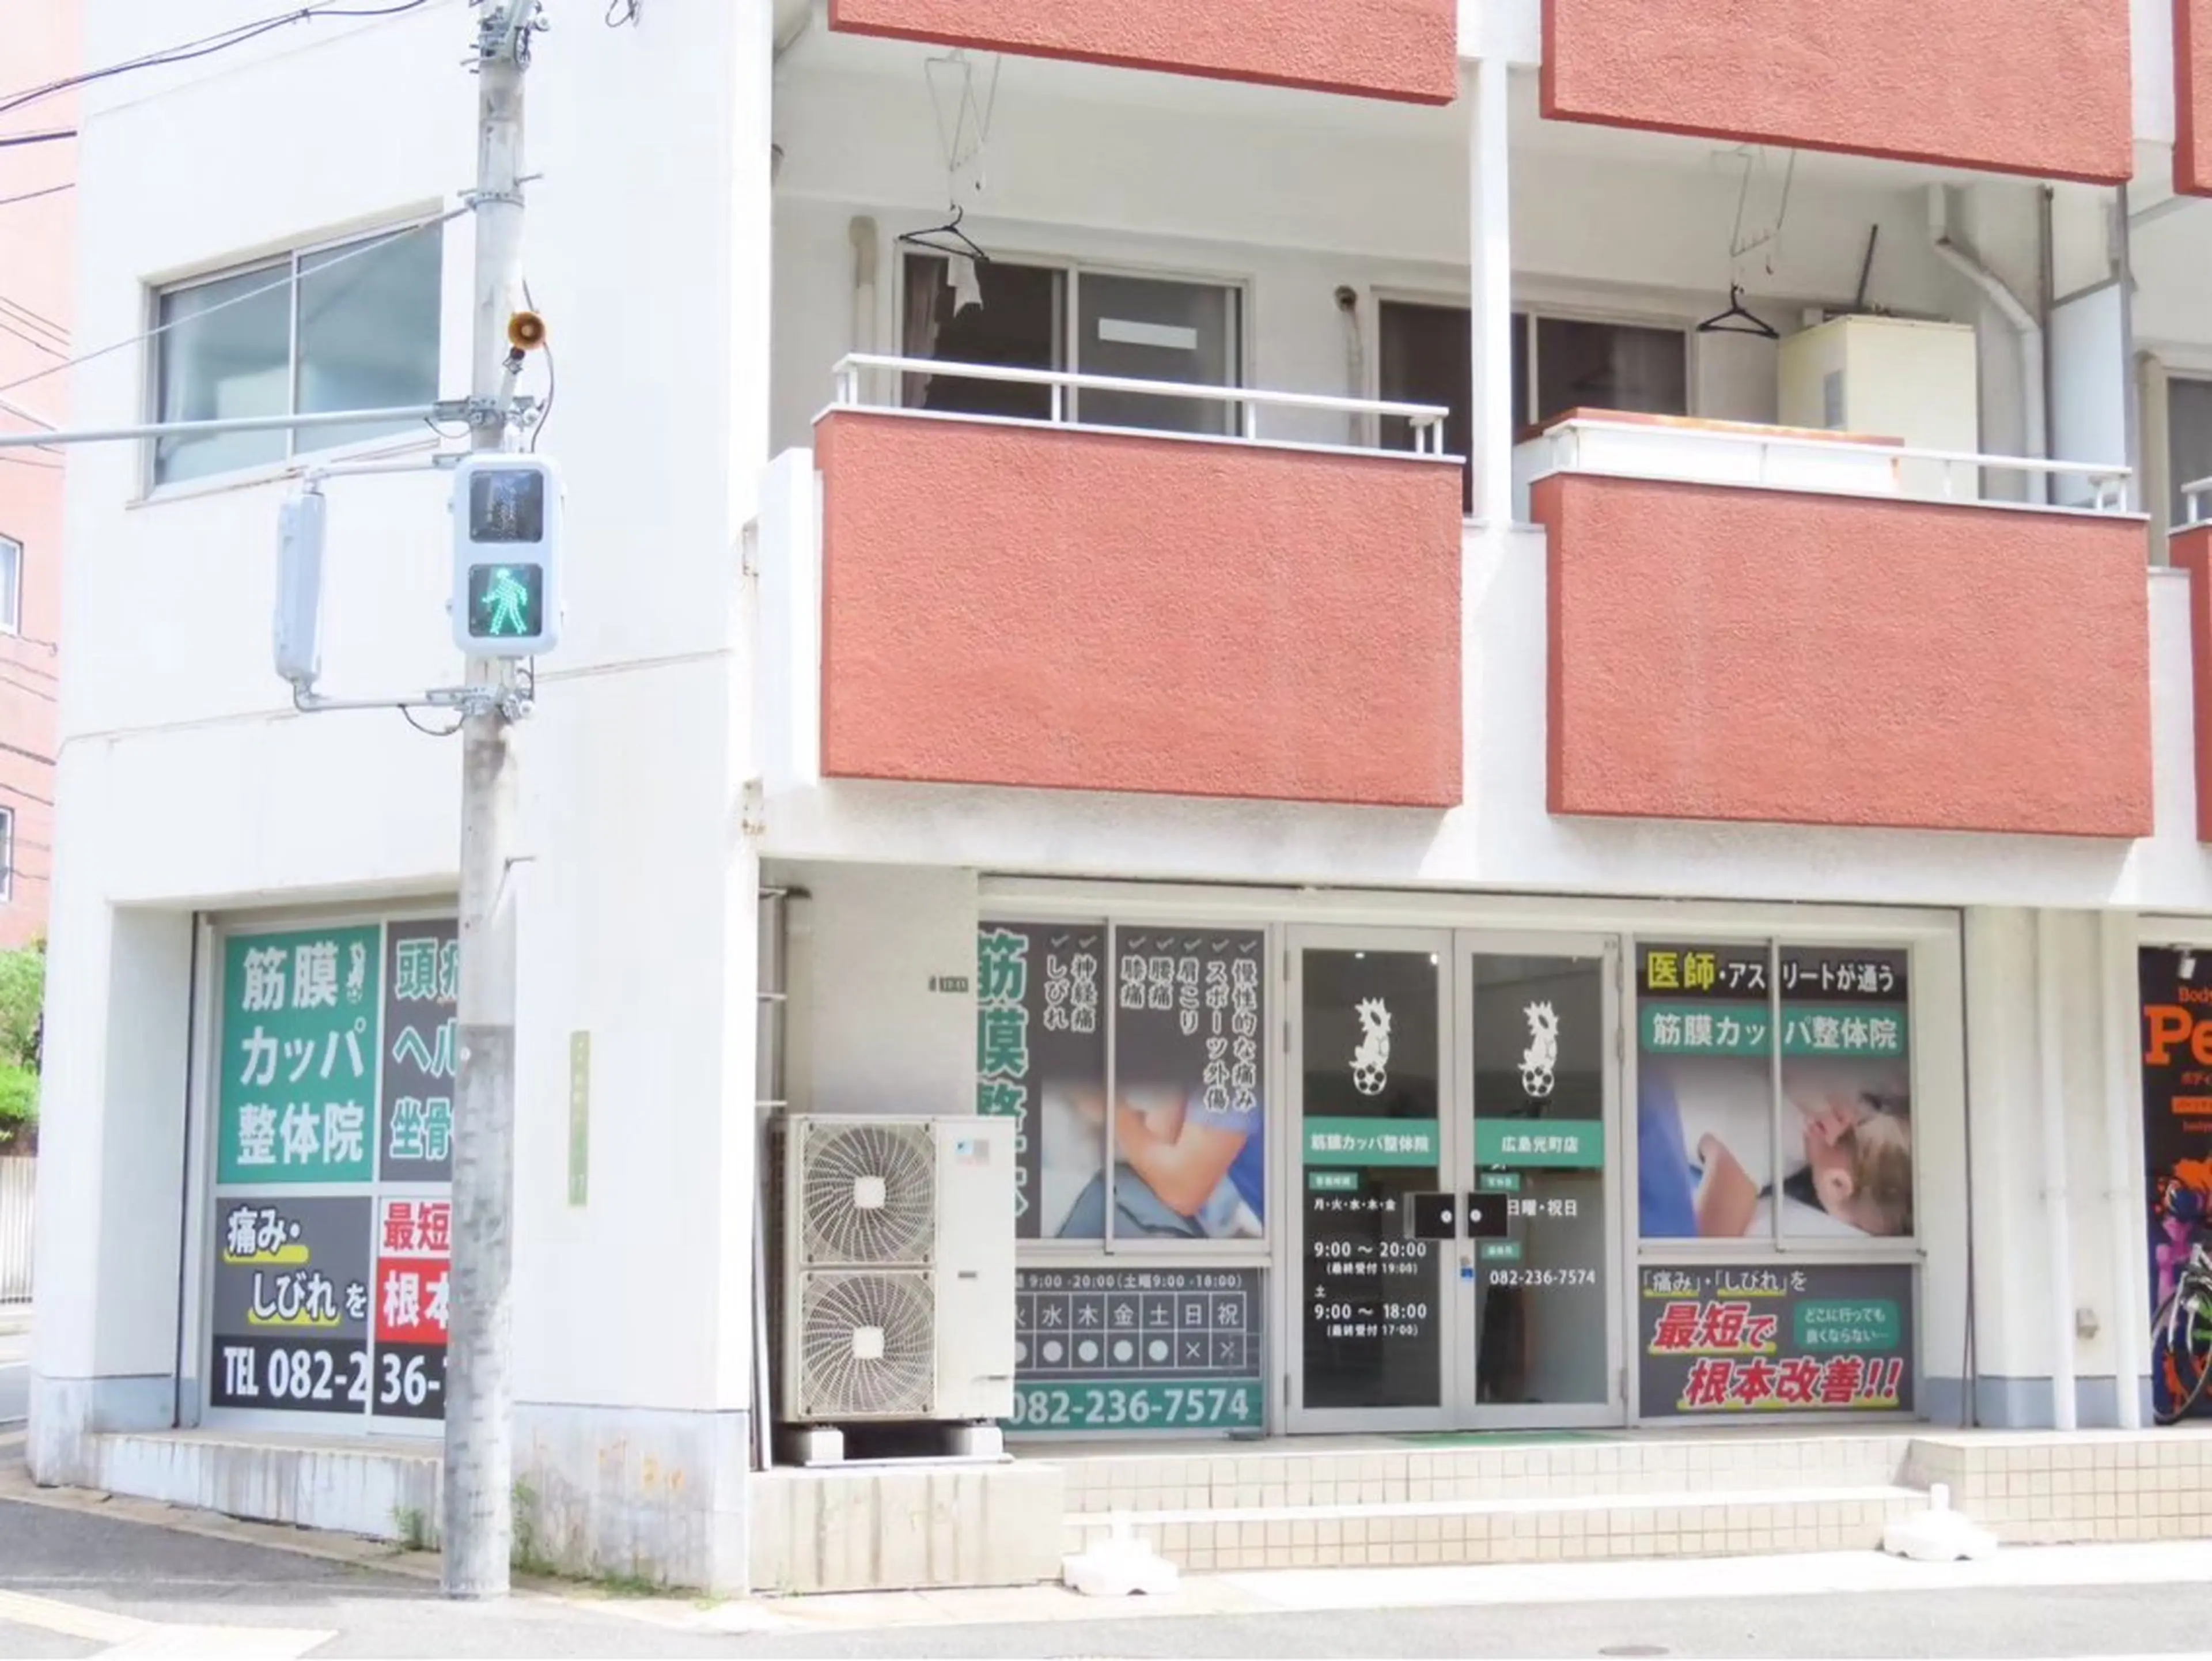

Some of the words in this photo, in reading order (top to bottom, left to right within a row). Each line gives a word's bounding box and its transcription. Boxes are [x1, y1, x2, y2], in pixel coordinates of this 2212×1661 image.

[242, 941, 340, 1012] 筋膜
[1043, 954, 1070, 1031] しびれ
[240, 1016, 367, 1086] カッパ
[1653, 1012, 1897, 1049] 筋膜カッパ整体院
[237, 1099, 364, 1165] 整体院
[390, 1096, 455, 1161] 坐骨
[1490, 1269, 1596, 1286] 082-236-7574
[1041, 1304, 1062, 1327] 水
[1078, 1304, 1099, 1325] 木
[1113, 1304, 1134, 1326] 金
[1150, 1303, 1169, 1325] 土
[1185, 1304, 1202, 1325] 日
[1217, 1304, 1239, 1326] 祝
[1651, 1300, 1778, 1352] 最短で
[224, 1346, 259, 1397] TEL
[1008, 1388, 1249, 1425] 082-236-7574
